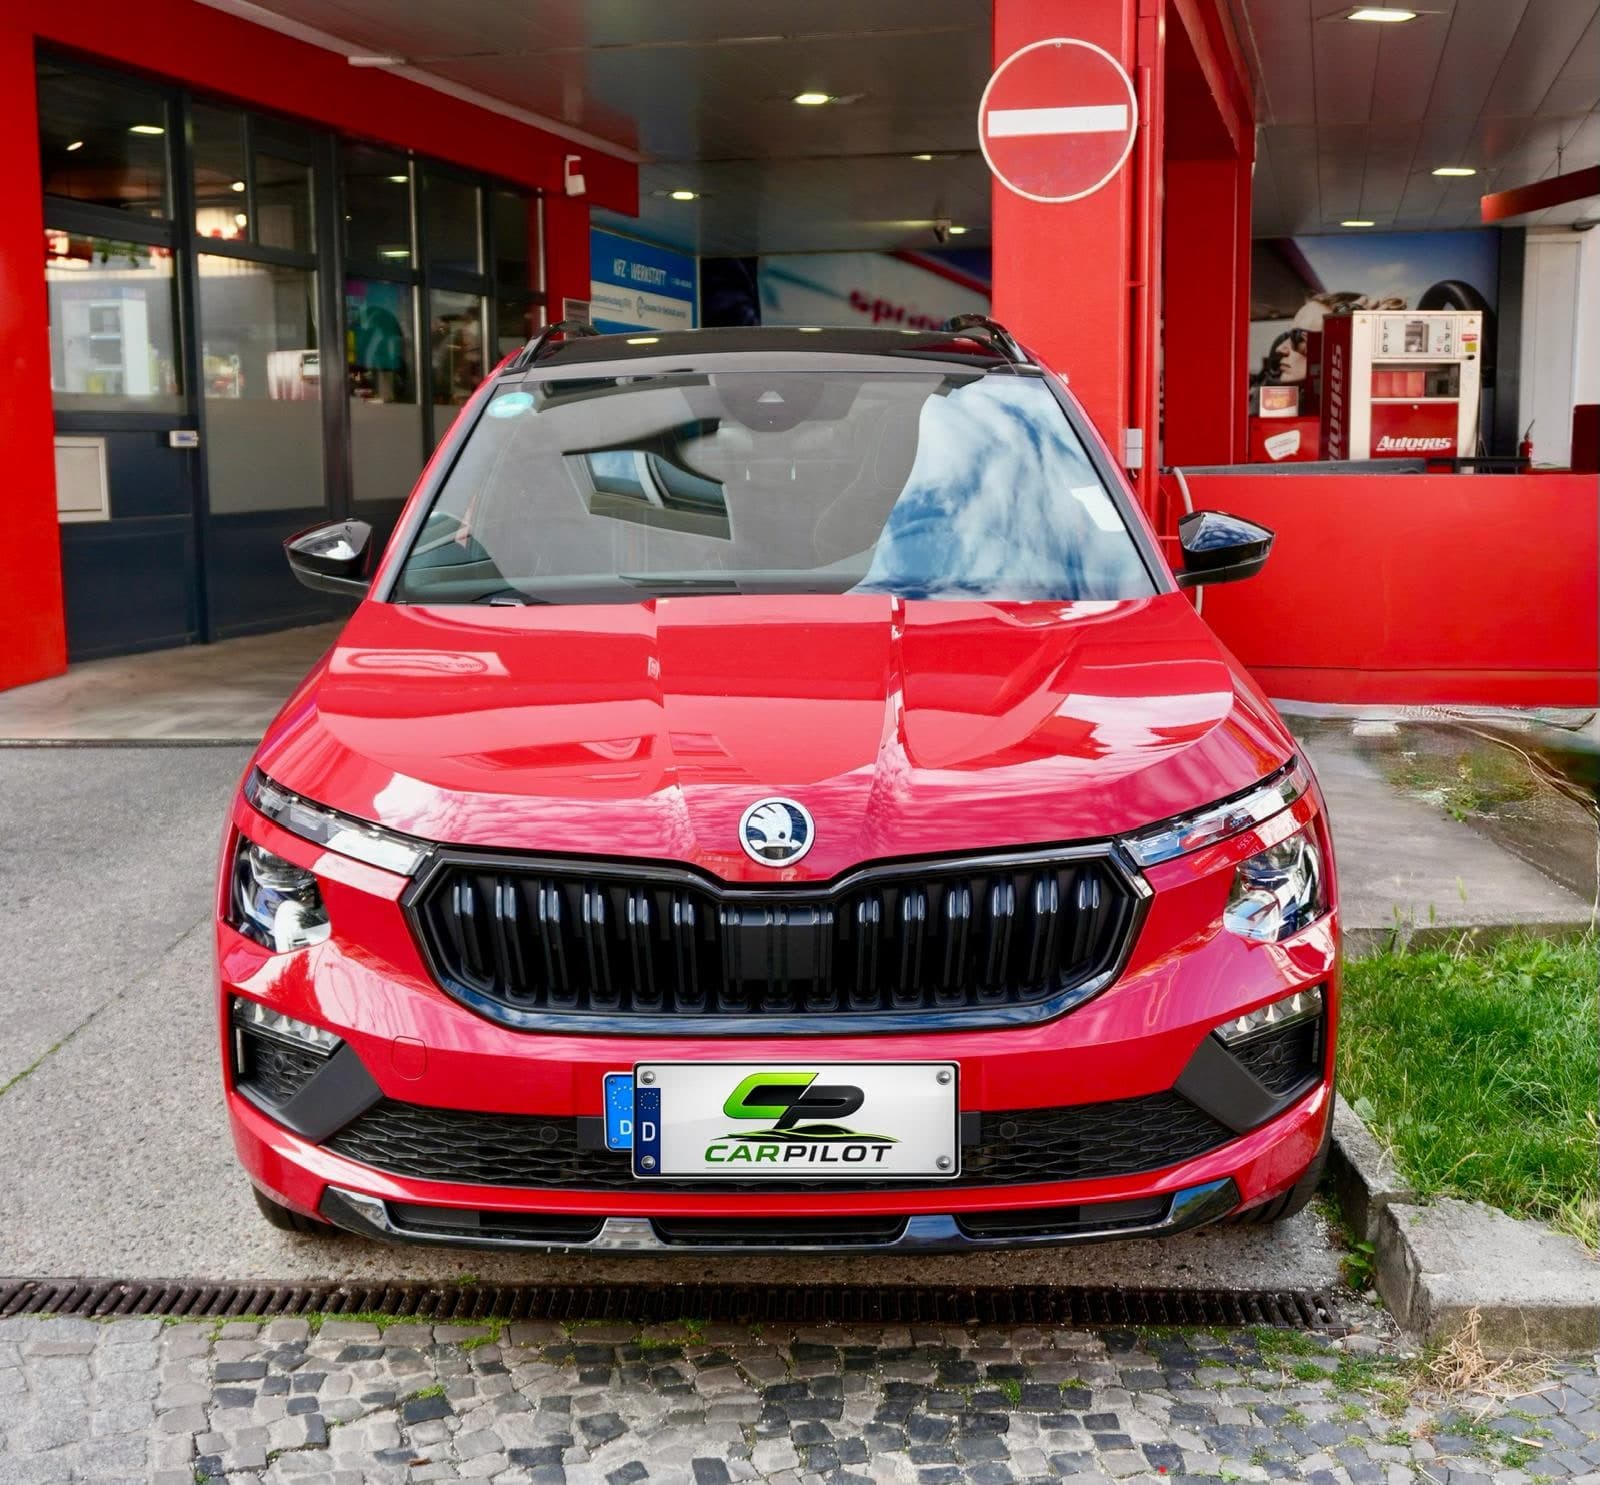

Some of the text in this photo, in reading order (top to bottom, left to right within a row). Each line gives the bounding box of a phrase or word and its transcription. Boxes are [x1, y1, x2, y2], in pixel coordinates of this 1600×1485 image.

[630, 263, 667, 287] WERKSTATT
[1327, 344, 1343, 461] togas
[1376, 435, 1452, 452] Autogas
[619, 1119, 633, 1136] D
